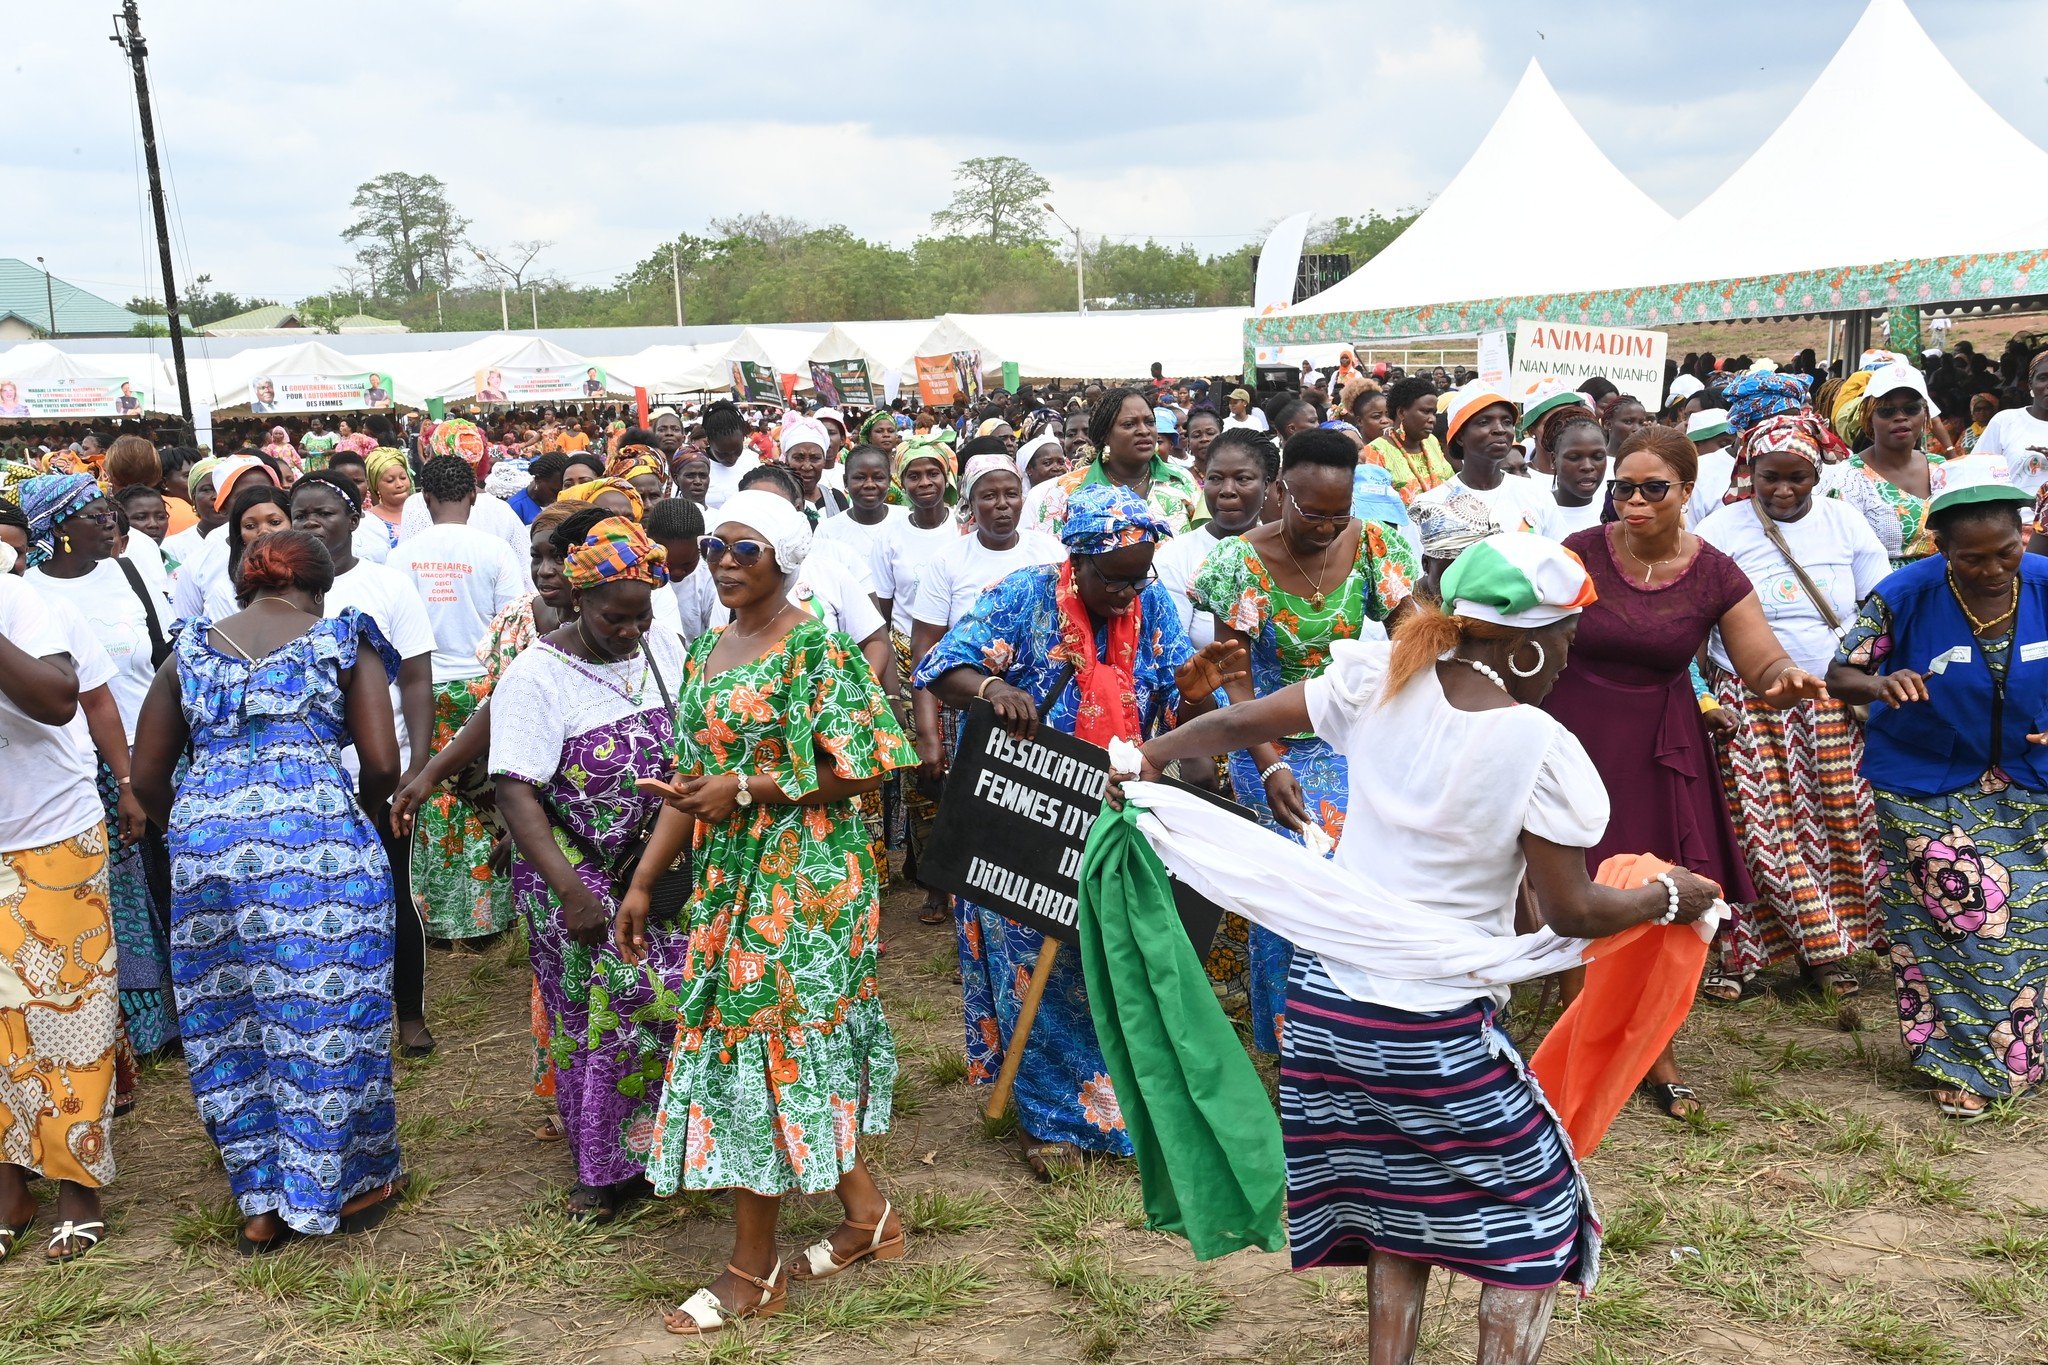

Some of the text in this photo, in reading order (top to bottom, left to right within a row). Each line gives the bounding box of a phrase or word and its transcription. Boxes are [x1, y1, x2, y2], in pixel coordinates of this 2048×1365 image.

[1530, 327, 1653, 358] ANIMADIM
[1519, 359, 1548, 374] NIAN
[1552, 361, 1575, 377] MIN
[1579, 364, 1608, 379] MAN
[1611, 367, 1658, 383] NIANHO
[289, 384, 336, 392] GOUVERNEMENT
[411, 562, 472, 574] PARTENAIRES
[974, 768, 1061, 828] FEMMES
